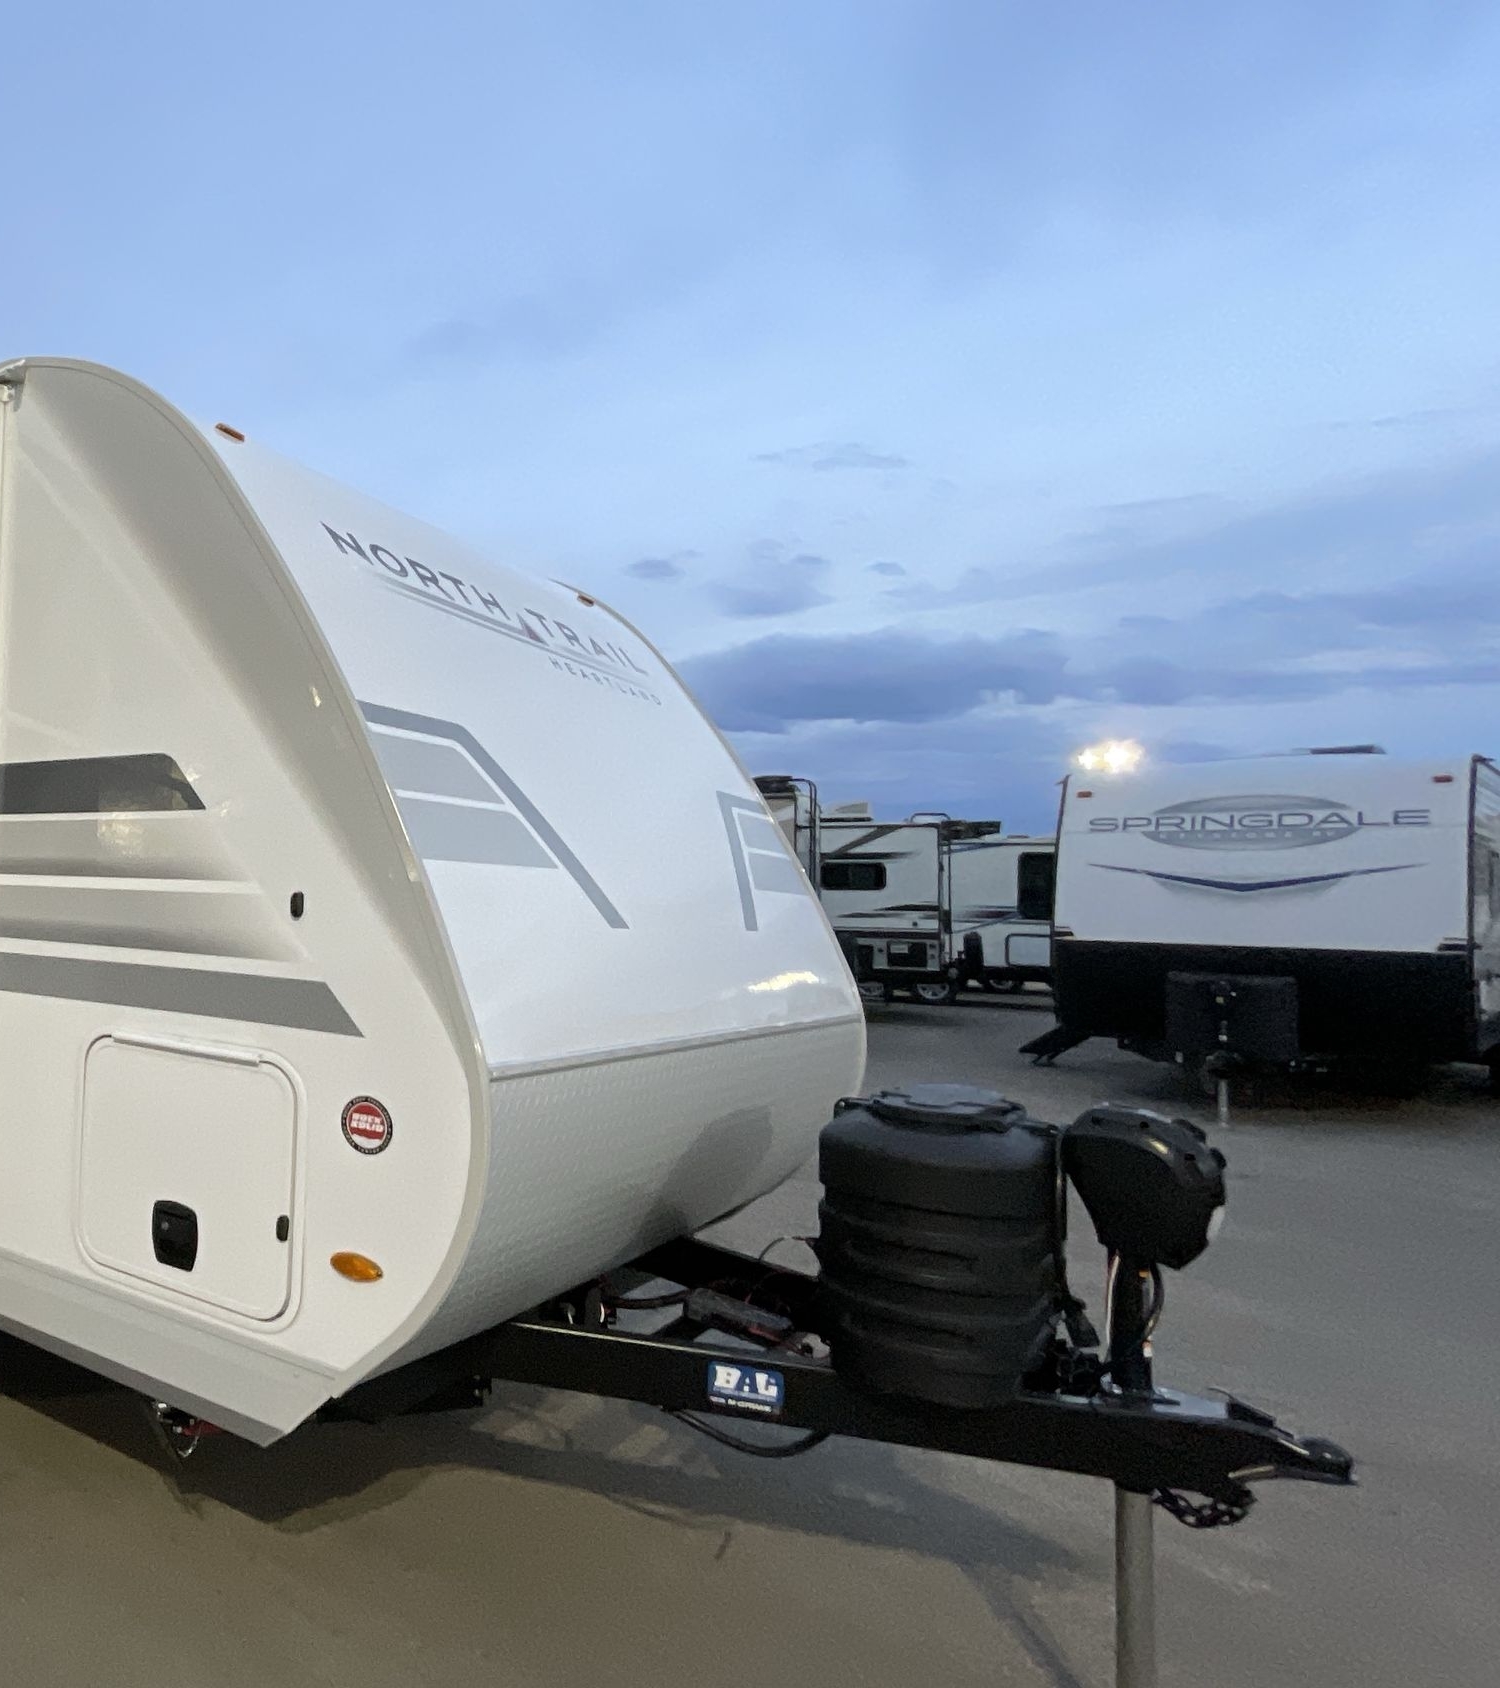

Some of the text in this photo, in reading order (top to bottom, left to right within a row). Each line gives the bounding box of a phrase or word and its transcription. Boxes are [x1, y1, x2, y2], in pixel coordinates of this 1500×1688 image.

[319, 521, 649, 677] NORTH TRAIL
[547, 655, 663, 706] HEARTLAND
[1089, 809, 1431, 833] SPRINGDALE
